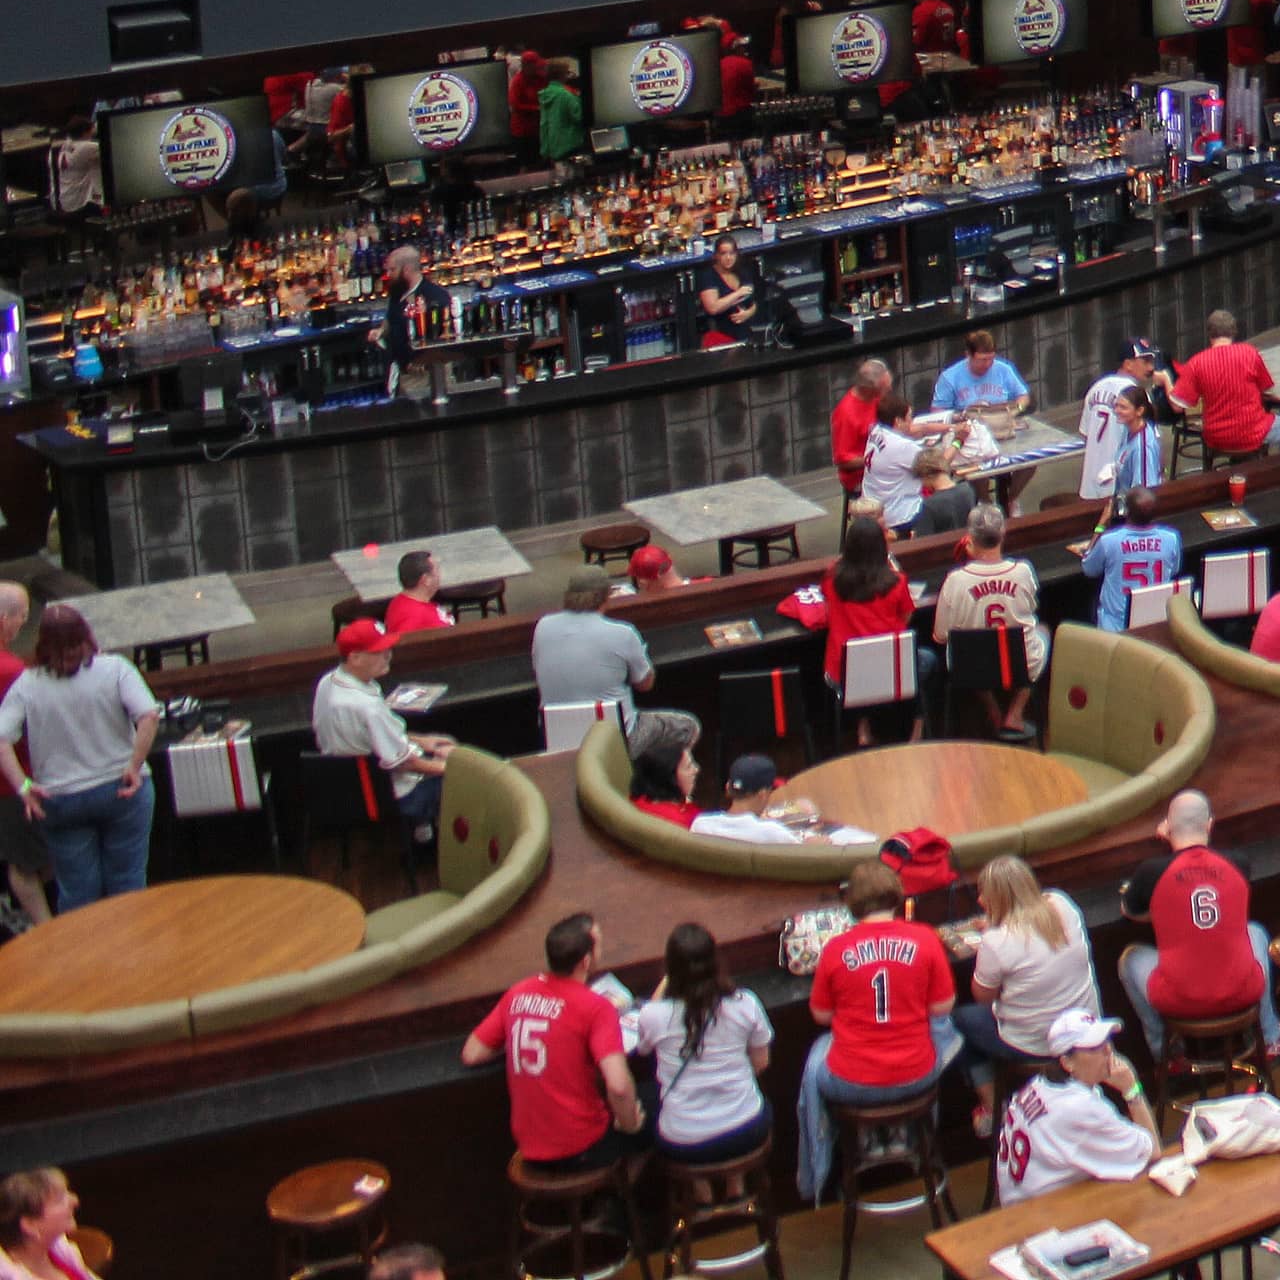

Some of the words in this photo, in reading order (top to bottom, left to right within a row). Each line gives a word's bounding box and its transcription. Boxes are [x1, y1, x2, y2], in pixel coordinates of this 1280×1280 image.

[1097, 410, 1109, 443] 7
[1121, 539, 1163, 555] McGEE
[969, 580, 1018, 601] MUSIAL
[1121, 560, 1163, 595] 51
[985, 603, 1008, 630] 6
[1190, 886, 1219, 930] 6
[841, 937, 917, 971] SMITH
[509, 992, 566, 1020] EDMONDS
[871, 967, 889, 1024] 1
[511, 1017, 550, 1077] 15
